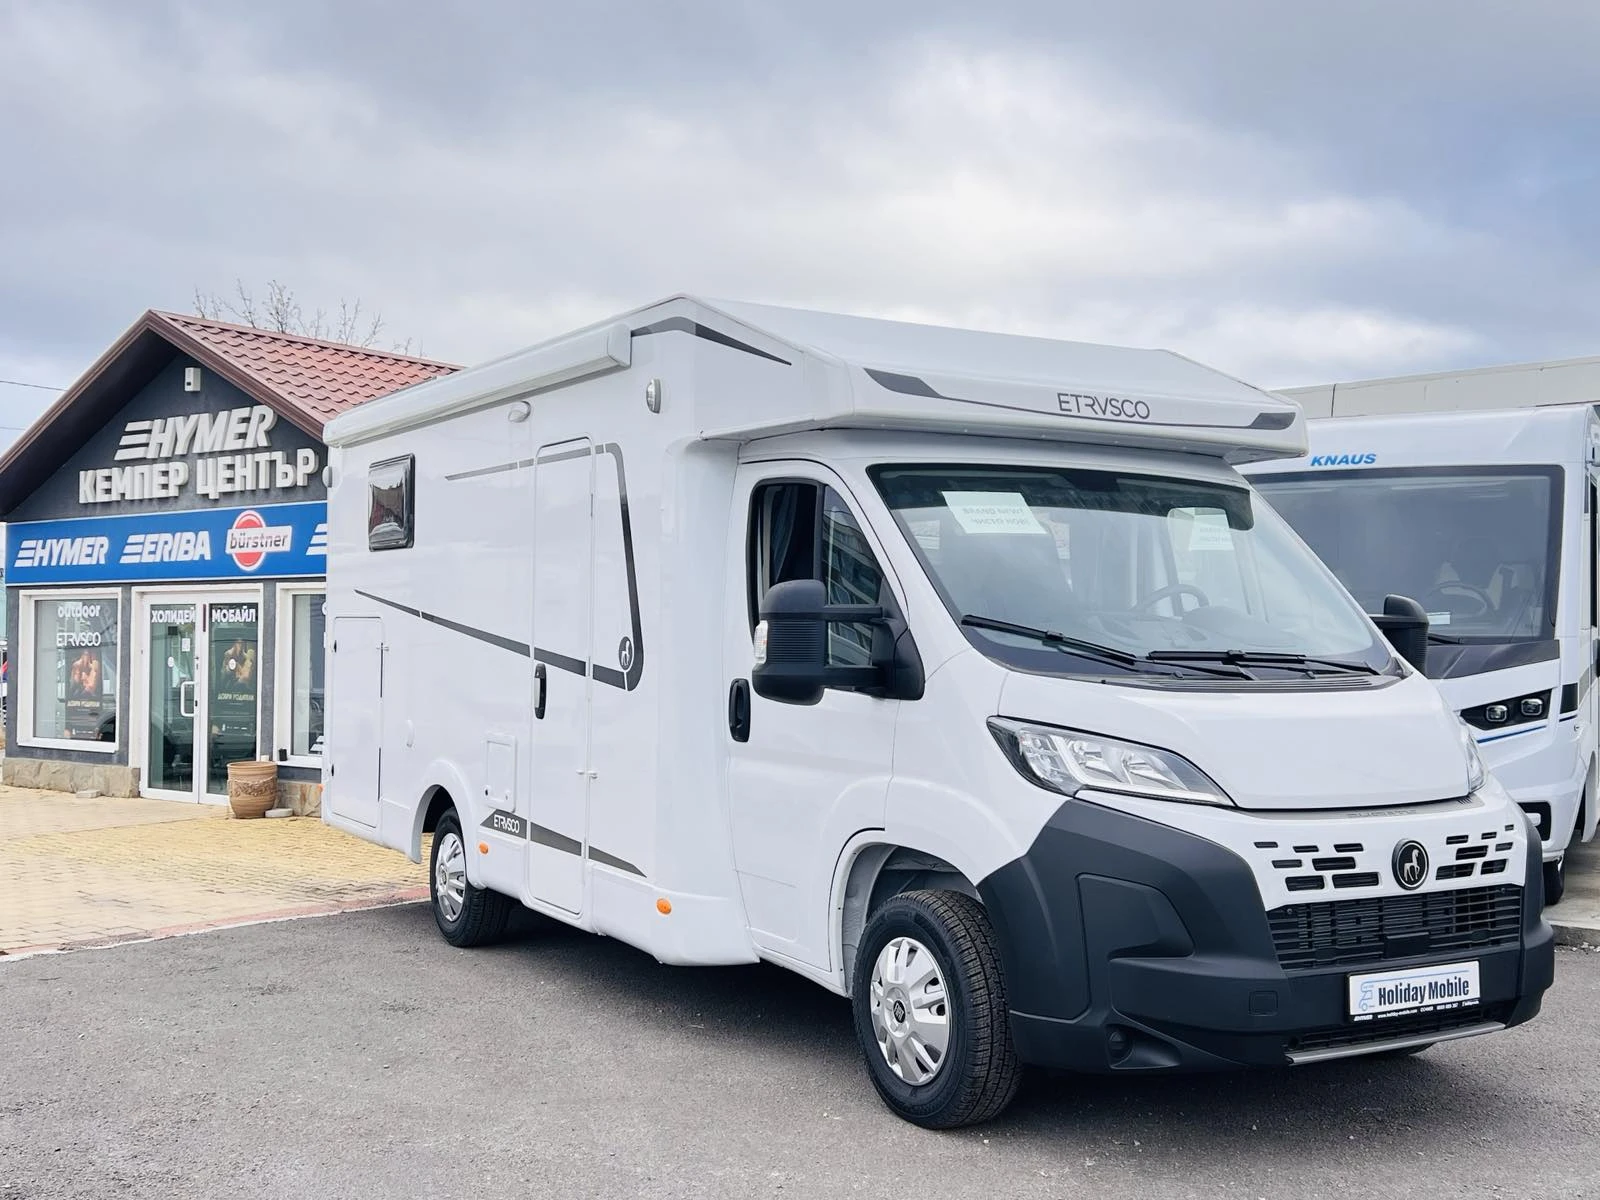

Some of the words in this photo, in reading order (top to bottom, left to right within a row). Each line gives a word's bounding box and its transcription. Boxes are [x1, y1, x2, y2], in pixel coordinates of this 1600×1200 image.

[114, 405, 274, 460] HYMER
[79, 461, 188, 504] КЕМПЕР
[196, 448, 319, 500] ЦЕНТЪР
[1311, 453, 1377, 467] KNAUS
[14, 536, 109, 567] HYMER
[119, 531, 211, 564] ERIBA
[230, 532, 288, 549] bürstner
[212, 606, 256, 622] МОБАЙЛ
[1378, 982, 1426, 1006] Holiday
[1428, 976, 1470, 1000] Mobile
